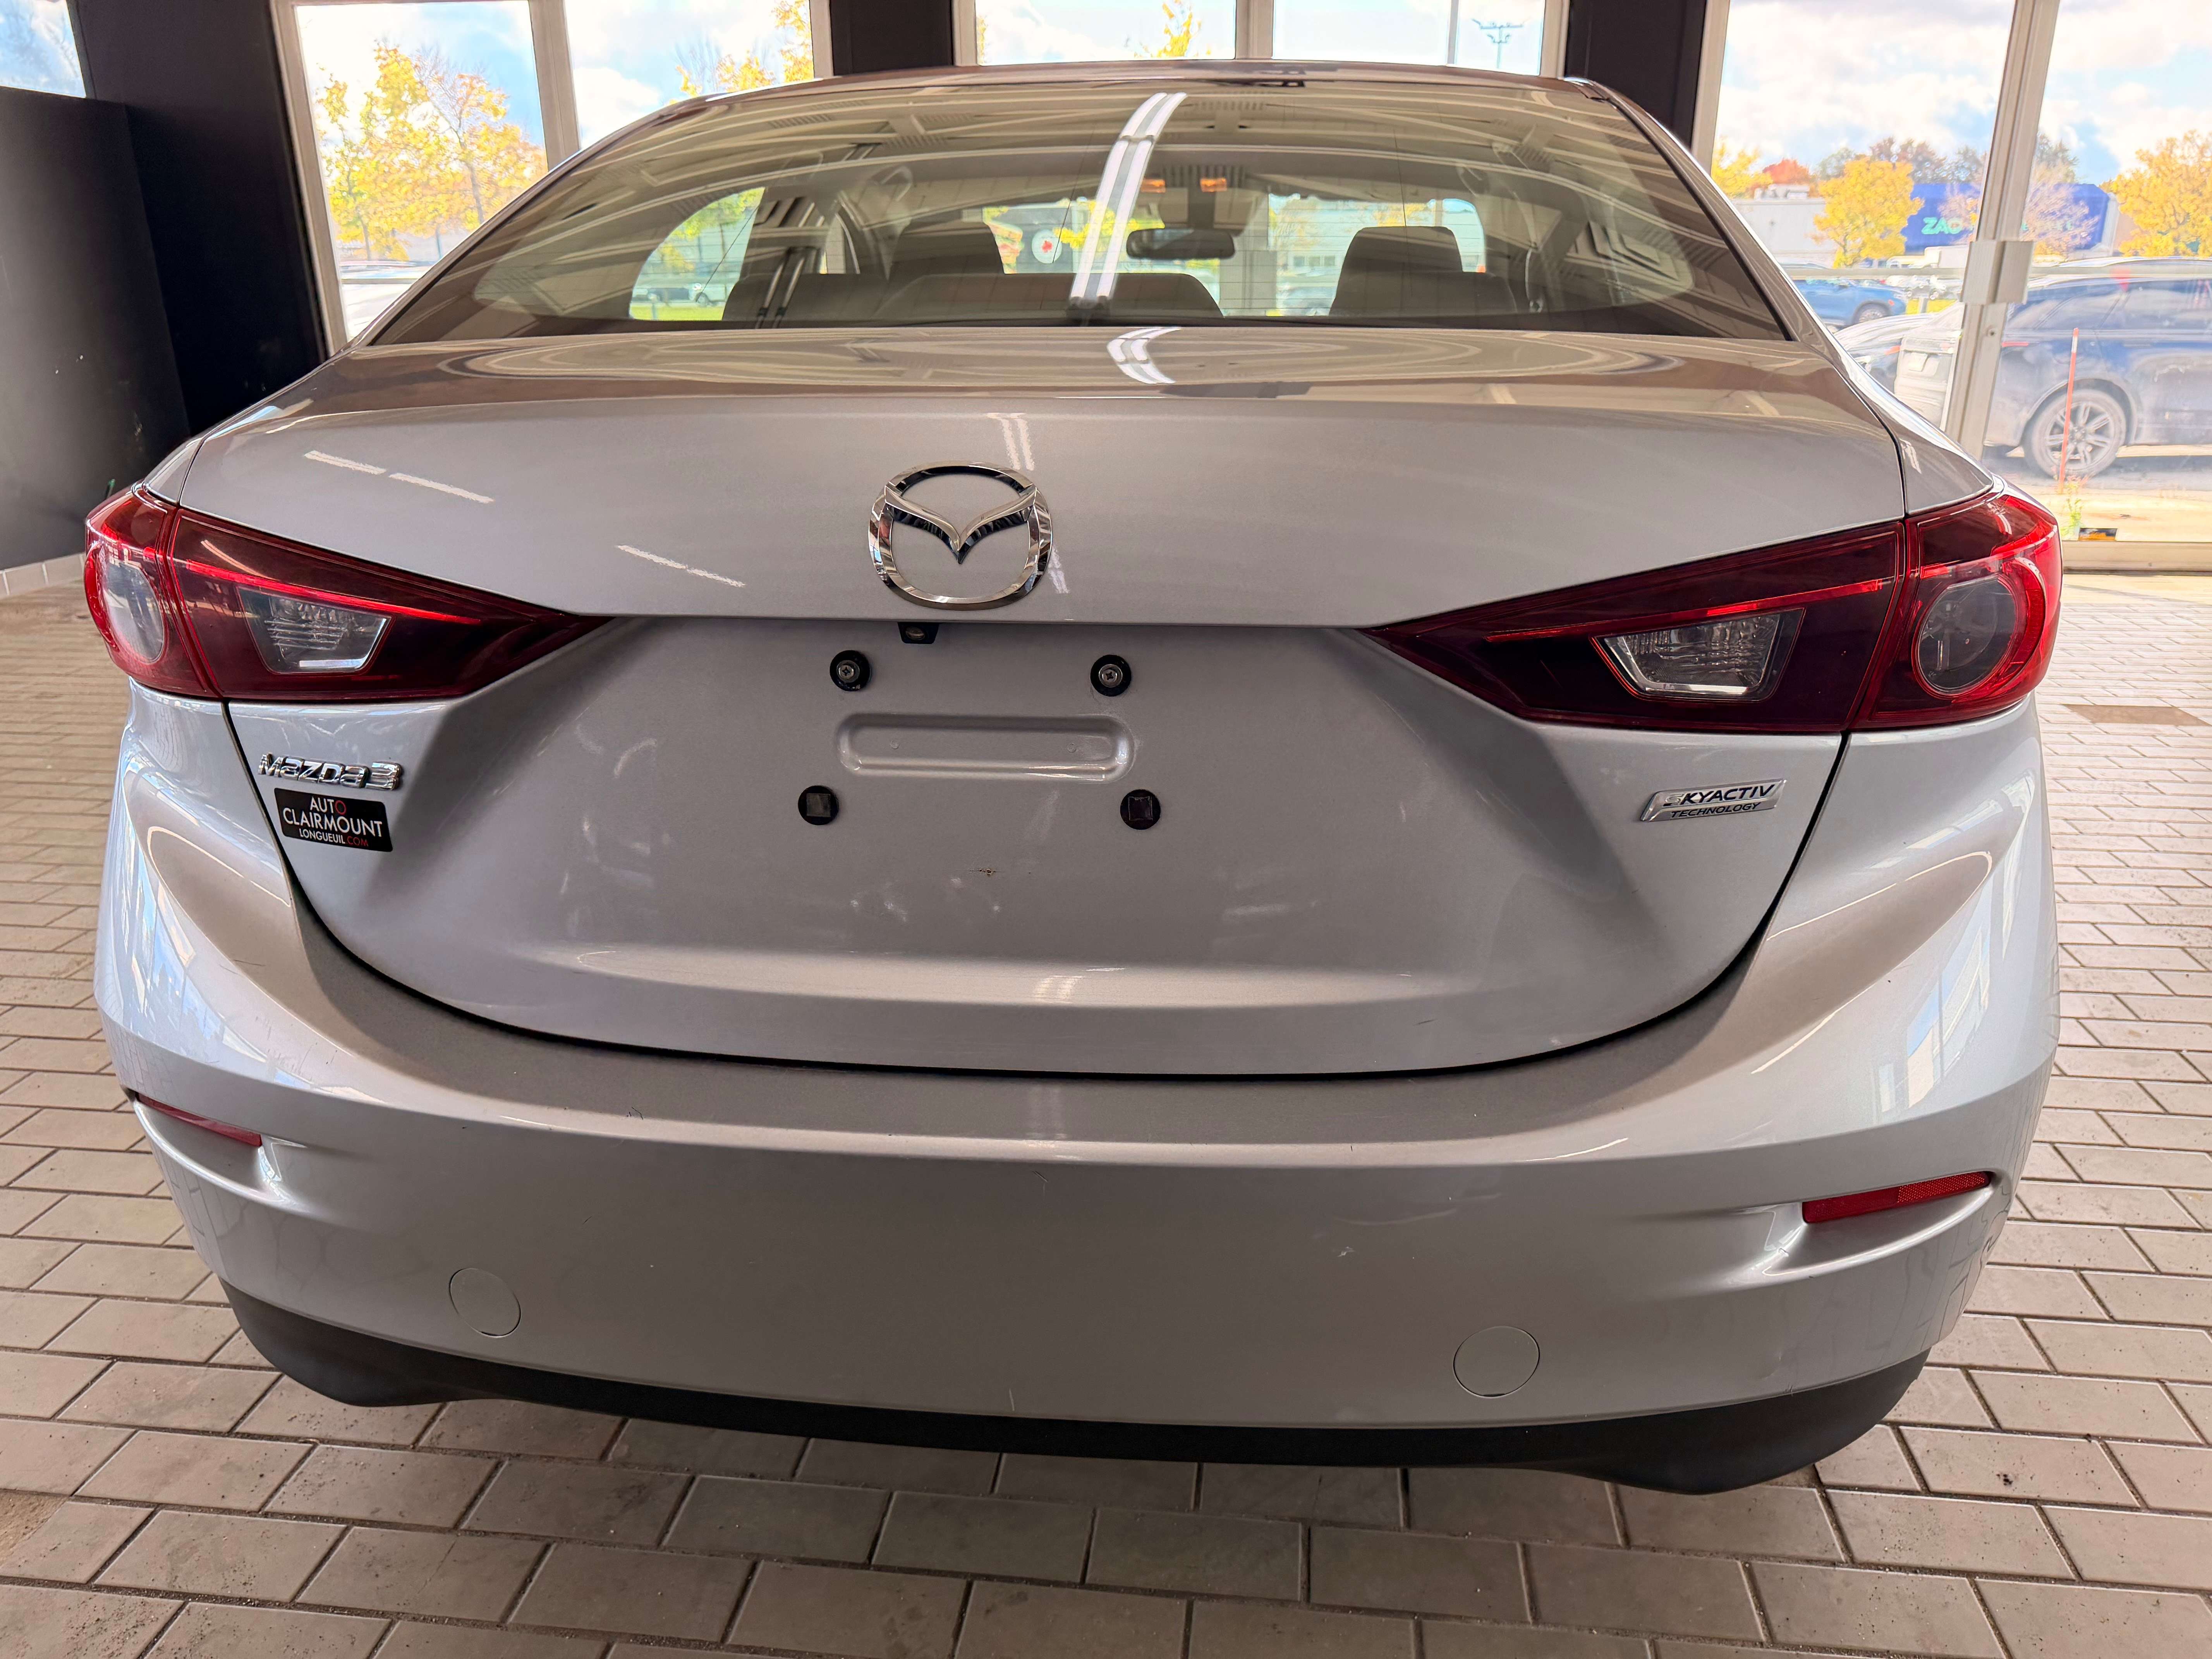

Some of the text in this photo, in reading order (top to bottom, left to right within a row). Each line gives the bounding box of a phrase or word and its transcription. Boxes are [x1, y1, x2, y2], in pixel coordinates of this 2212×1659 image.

[1664, 784, 1775, 806] SKYACTIV
[310, 796, 346, 815] AUTO
[1670, 802, 1761, 818] TECHNOLOGY
[283, 807, 382, 837] CLAIRMOUNT
[299, 828, 368, 847] LONGUEUIL.COM
